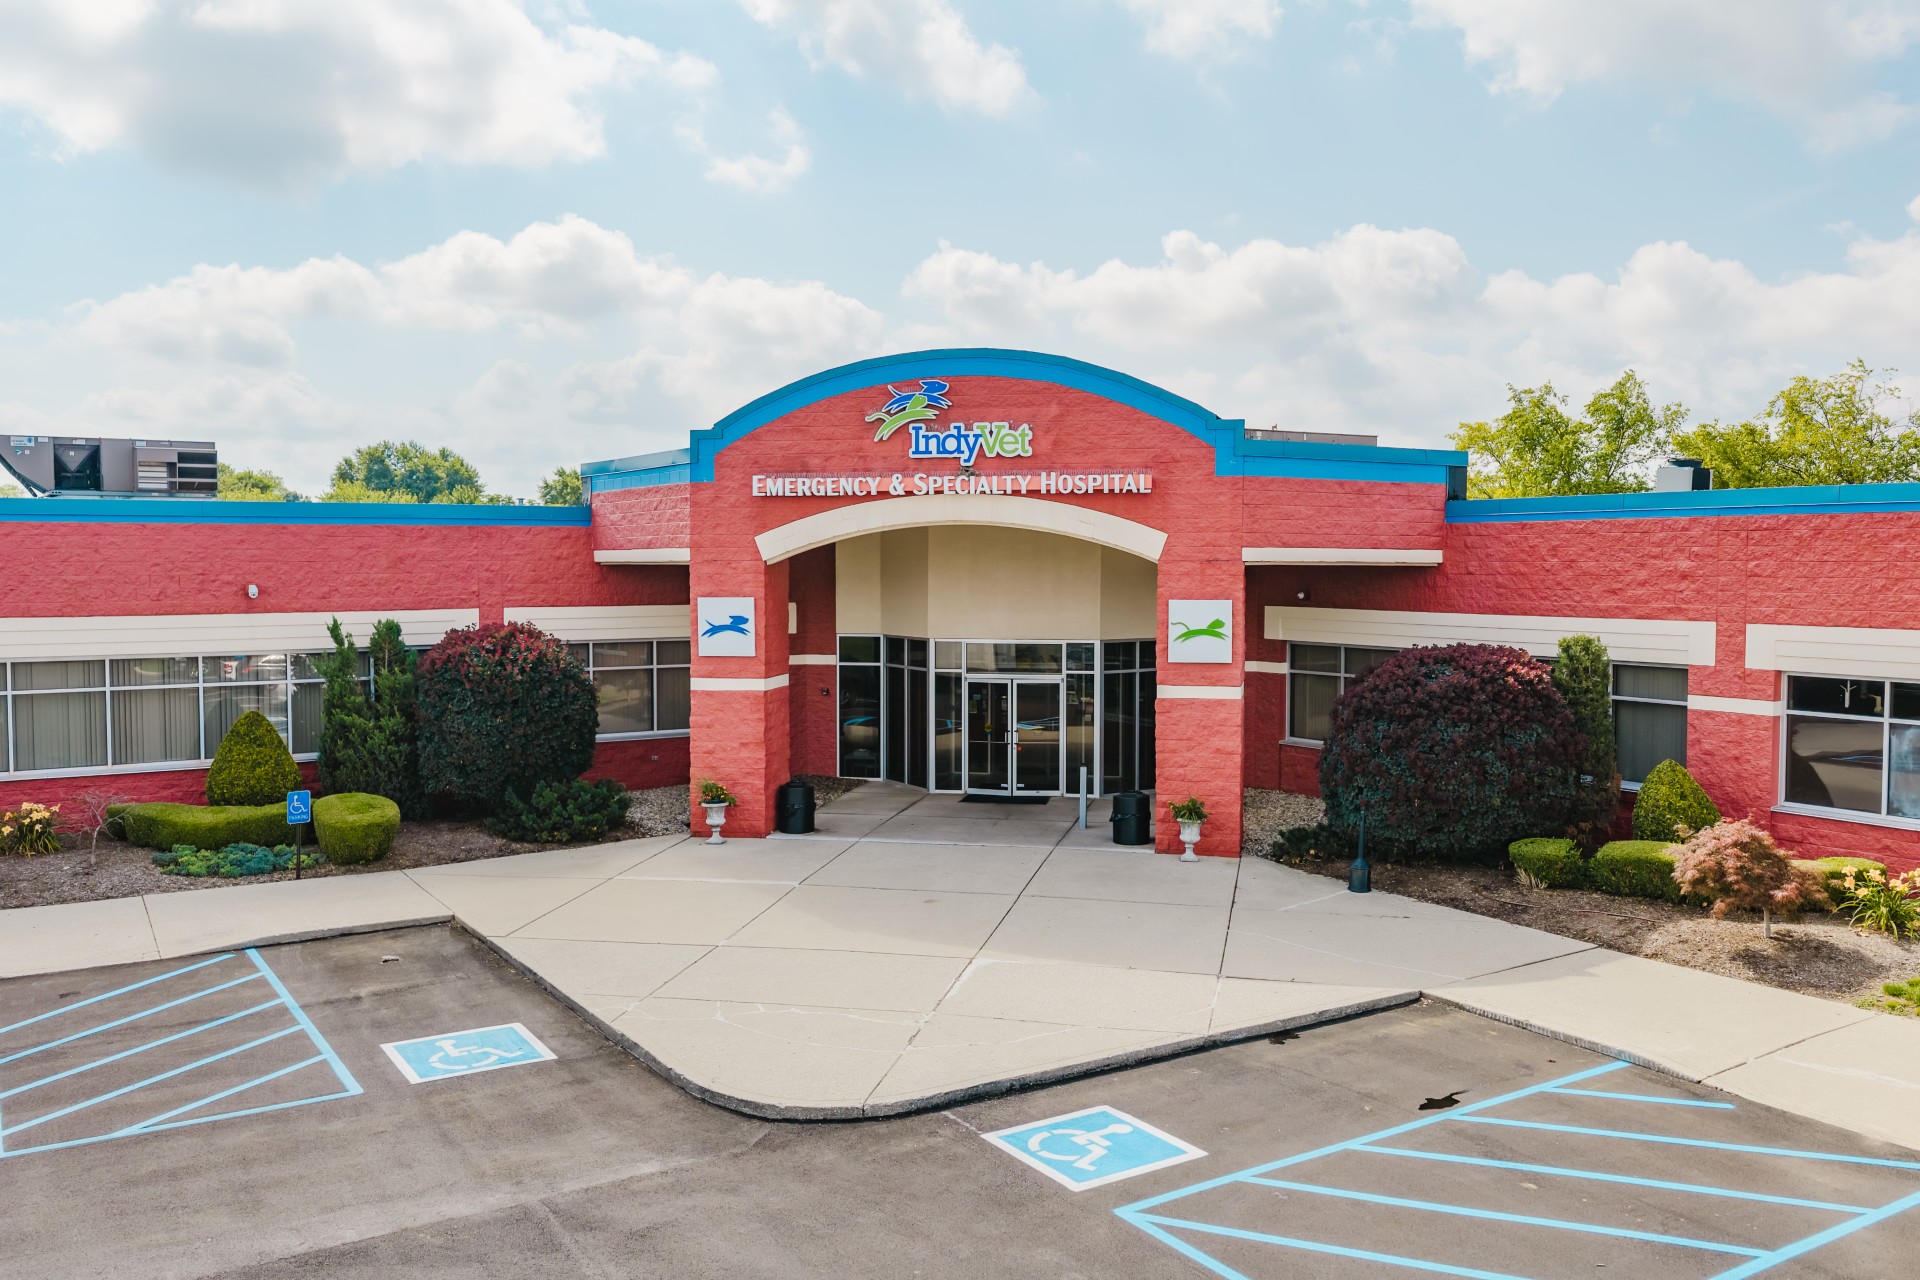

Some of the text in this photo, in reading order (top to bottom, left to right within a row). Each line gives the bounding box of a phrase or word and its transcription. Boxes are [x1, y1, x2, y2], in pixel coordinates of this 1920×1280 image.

[911, 423, 1030, 464] IndyVet
[752, 471, 1152, 497] EMERGENCY & SPECIALTY HOSPITAL
